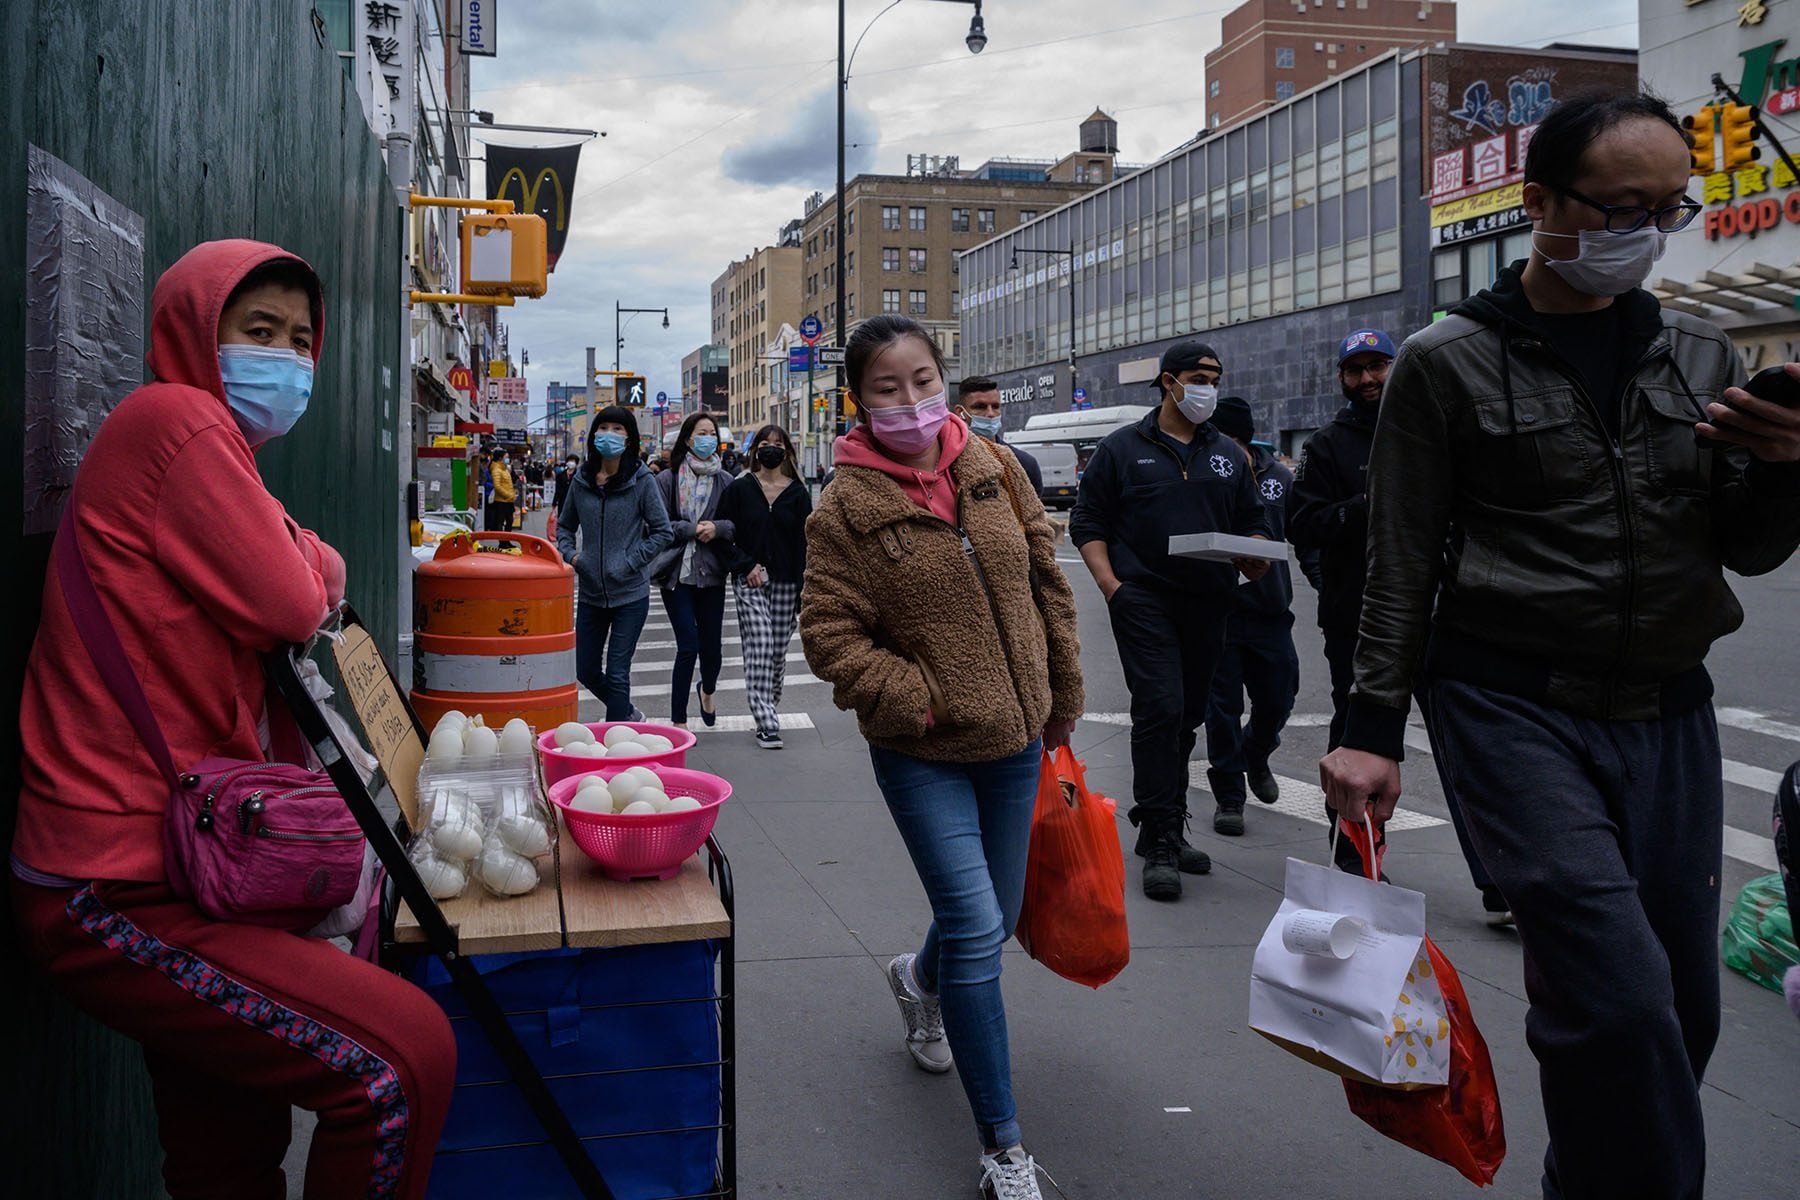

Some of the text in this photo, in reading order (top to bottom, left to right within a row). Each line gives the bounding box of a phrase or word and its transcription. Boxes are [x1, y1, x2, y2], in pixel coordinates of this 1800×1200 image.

[469, 1, 485, 48] ental
[1705, 199, 1779, 241] FOOD
[825, 352, 840, 360] ONE
[1038, 375, 1055, 387] OPEN
